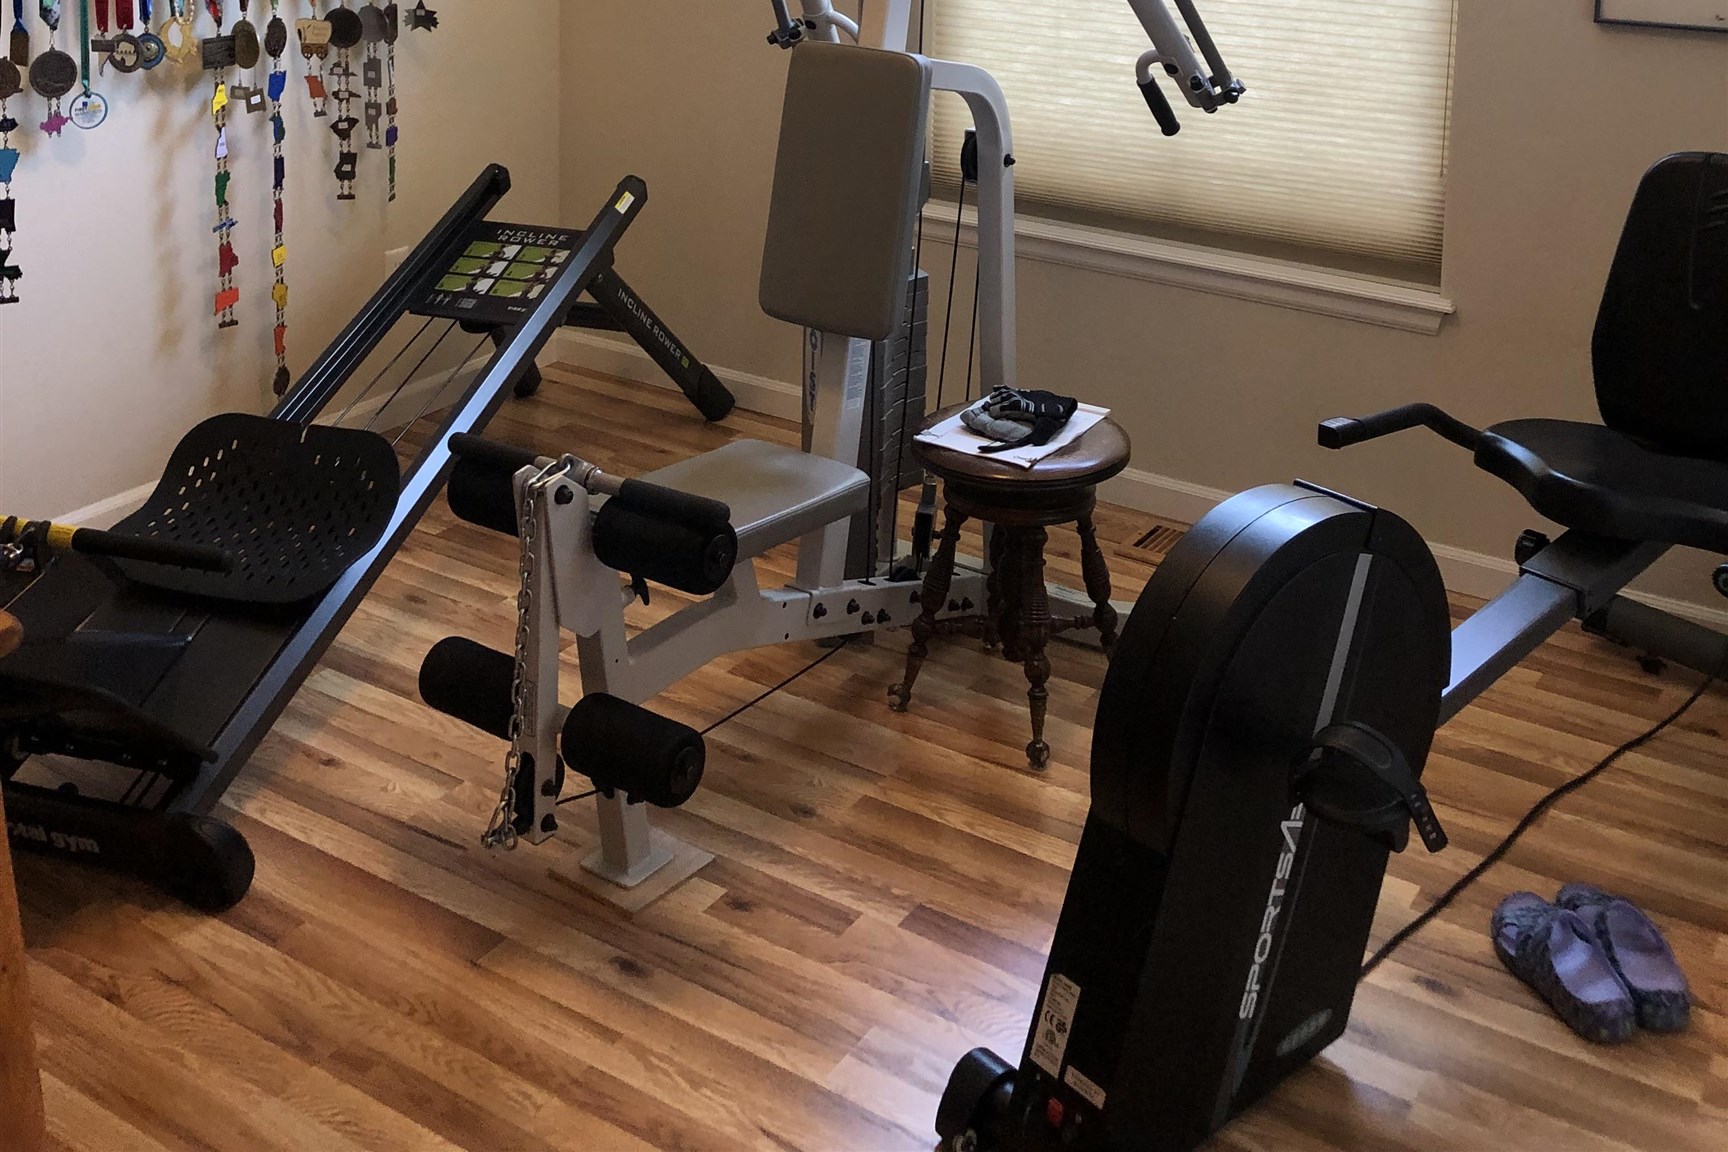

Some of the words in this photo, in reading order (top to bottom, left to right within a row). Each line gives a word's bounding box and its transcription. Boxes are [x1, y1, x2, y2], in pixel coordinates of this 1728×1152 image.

[496, 229, 570, 241] INCLINE
[497, 235, 559, 246] ROWER
[617, 288, 653, 330] INCLINE
[652, 324, 682, 360] ROWER
